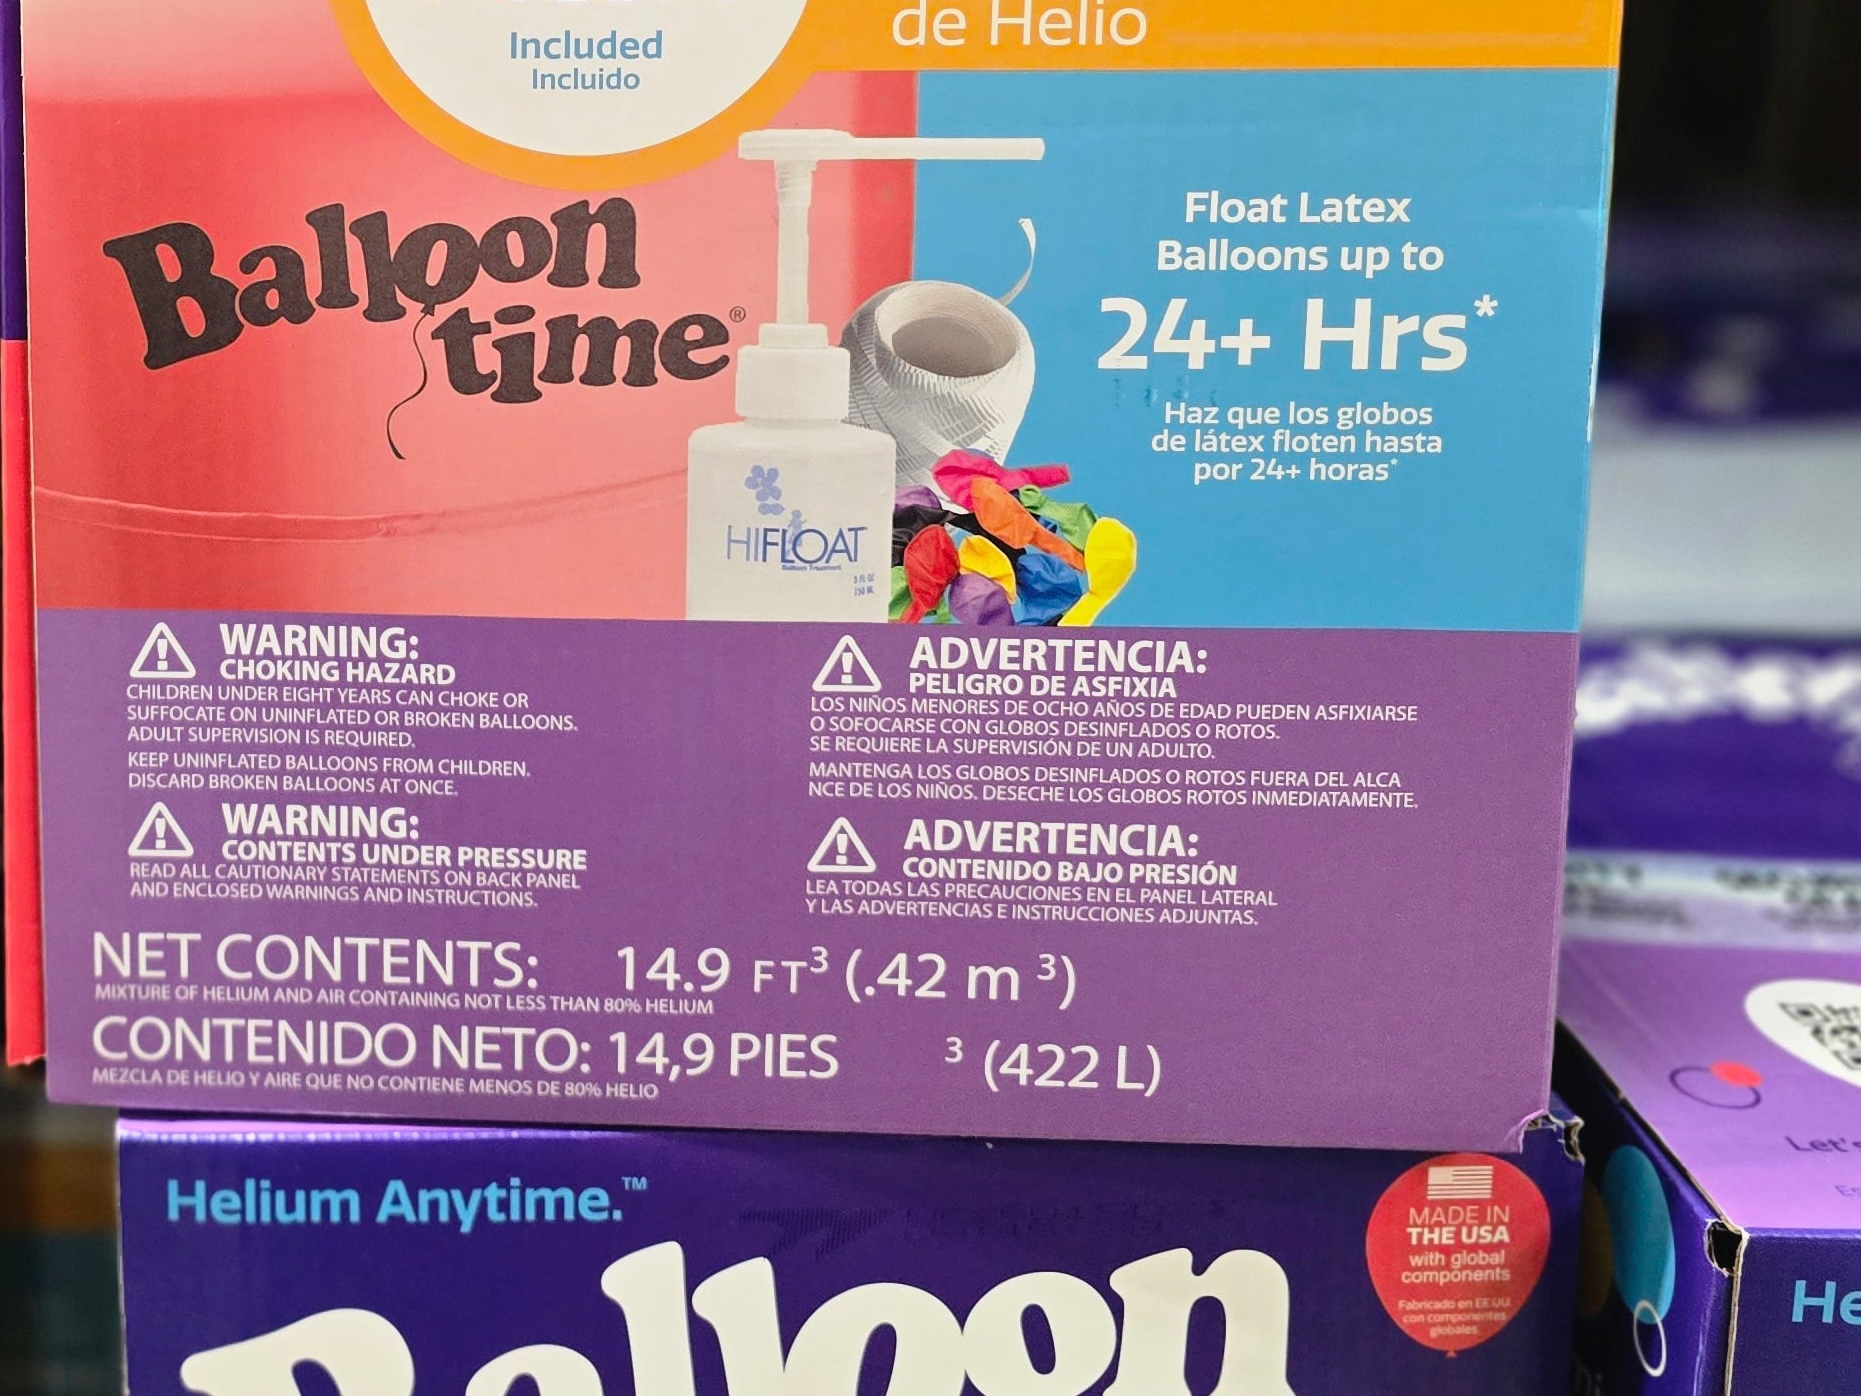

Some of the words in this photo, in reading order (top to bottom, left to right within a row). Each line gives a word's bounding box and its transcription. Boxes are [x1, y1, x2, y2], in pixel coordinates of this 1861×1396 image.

[510, 29, 663, 60] Included
[532, 67, 641, 91] Incluido
[1185, 190, 1289, 224] Float
[1299, 191, 1412, 223] Latex
[1157, 238, 1329, 271] Balloons
[1340, 245, 1390, 279] up
[1401, 241, 1444, 271] to
[103, 197, 643, 371] Balloon
[1097, 296, 1271, 370] 24+
[1164, 401, 1220, 424] Haz
[1227, 406, 1281, 430] que
[1288, 400, 1329, 425] los
[1336, 401, 1433, 431] globos
[1151, 428, 1187, 452] de
[1194, 428, 1266, 453] látex
[1272, 428, 1356, 453] floten
[1365, 429, 1443, 454] hasta
[1193, 462, 1244, 486] por
[1249, 457, 1302, 481] 24+
[727, 525, 868, 564] HIFLOAT
[219, 623, 419, 660] WARNING:
[909, 636, 1208, 674] ADVERTENCIA:
[219, 658, 340, 682] CHOKING
[346, 661, 456, 686] HAZARD
[909, 672, 1024, 696] PELIGRO
[1030, 674, 1067, 697] DE
[1071, 675, 1178, 699] ASFIXIA
[126, 683, 213, 701] CHILDREN
[217, 685, 279, 702] UNDER
[282, 686, 335, 703] EIGHT
[337, 687, 392, 705] YEARS
[395, 689, 434, 707] CAN
[437, 690, 499, 708] CHOKE
[502, 692, 529, 709] OR
[221, 802, 419, 840] WARNING:
[903, 818, 1199, 858] ADVERTENCIA:
[221, 839, 357, 864] CONTENTS
[362, 843, 452, 867] UNDER
[457, 846, 587, 871] PRESSURE
[902, 856, 1052, 882] CONTENIDO
[1057, 860, 1124, 884] BAJO
[1129, 860, 1238, 886] PRESIÓN
[93, 931, 202, 979] NET
[216, 933, 539, 989] CONTENTS:
[617, 946, 731, 993] 14.9
[845, 948, 947, 1004] (.42
[92, 1015, 417, 1068] CONTENIDO
[432, 1024, 591, 1074] NETO:
[609, 1031, 715, 1083] 14,9
[729, 1032, 839, 1080] PIES
[984, 1039, 1099, 1093] (422
[1116, 1044, 1161, 1098] L)
[167, 1177, 361, 1225] Helium
[1409, 1205, 1479, 1226] MADE
[1486, 1205, 1510, 1223] IN
[1406, 1225, 1457, 1246] THE
[1460, 1224, 1511, 1245] USA
[180, 1241, 1296, 1396] lloon
